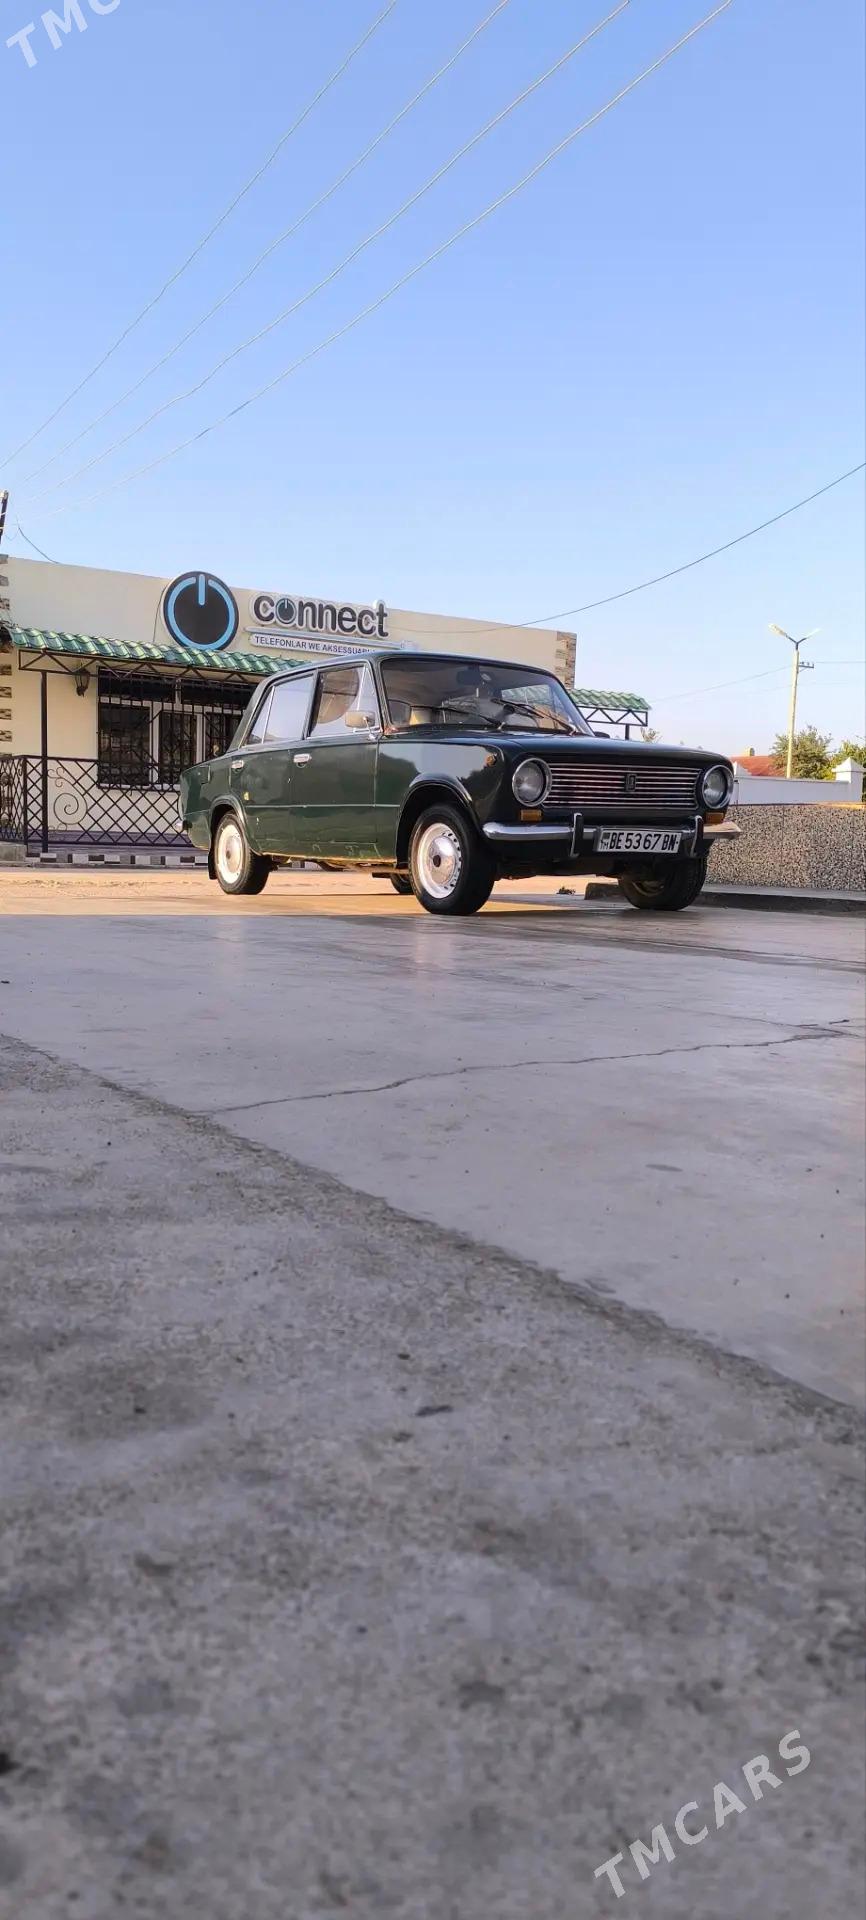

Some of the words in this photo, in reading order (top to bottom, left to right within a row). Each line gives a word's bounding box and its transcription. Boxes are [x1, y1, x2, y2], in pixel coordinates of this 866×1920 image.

[253, 595, 389, 637] connect
[254, 635, 307, 649] TELEFONLAR
[308, 642, 321, 650] WE
[609, 832, 624, 849] BE
